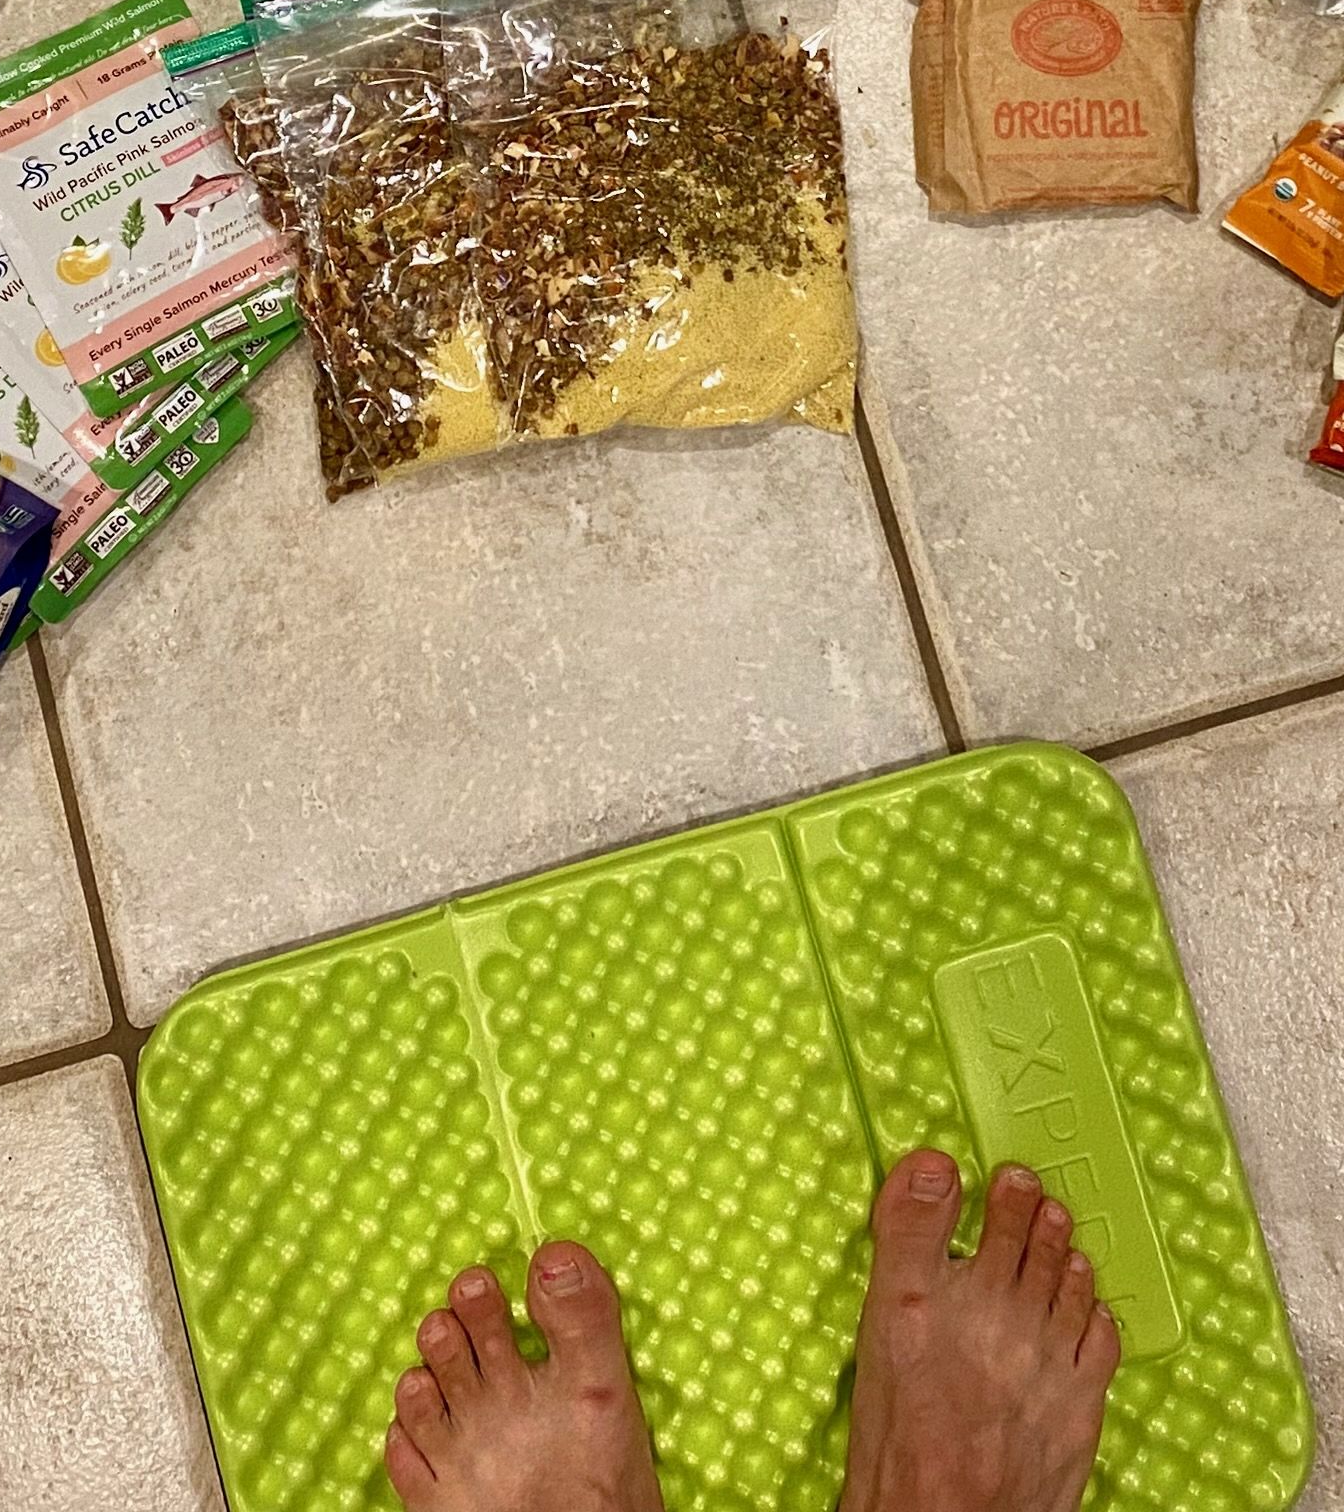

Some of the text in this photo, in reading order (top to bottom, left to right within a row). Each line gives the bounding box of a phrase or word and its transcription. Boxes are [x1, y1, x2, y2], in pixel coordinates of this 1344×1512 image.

[19, 49, 58, 73] Cooked
[58, 28, 102, 54] Premium
[97, 58, 147, 85] 18 Grams
[33, 187, 66, 212] Wild
[70, 161, 116, 189] Pacific
[117, 145, 148, 166] Pink
[60, 161, 161, 222] CITRUS DILL
[89, 335, 123, 361] Every
[124, 313, 162, 341] Single
[163, 291, 207, 319] Salmon
[210, 263, 258, 293] Mercury
[157, 337, 198, 366] PALEO
